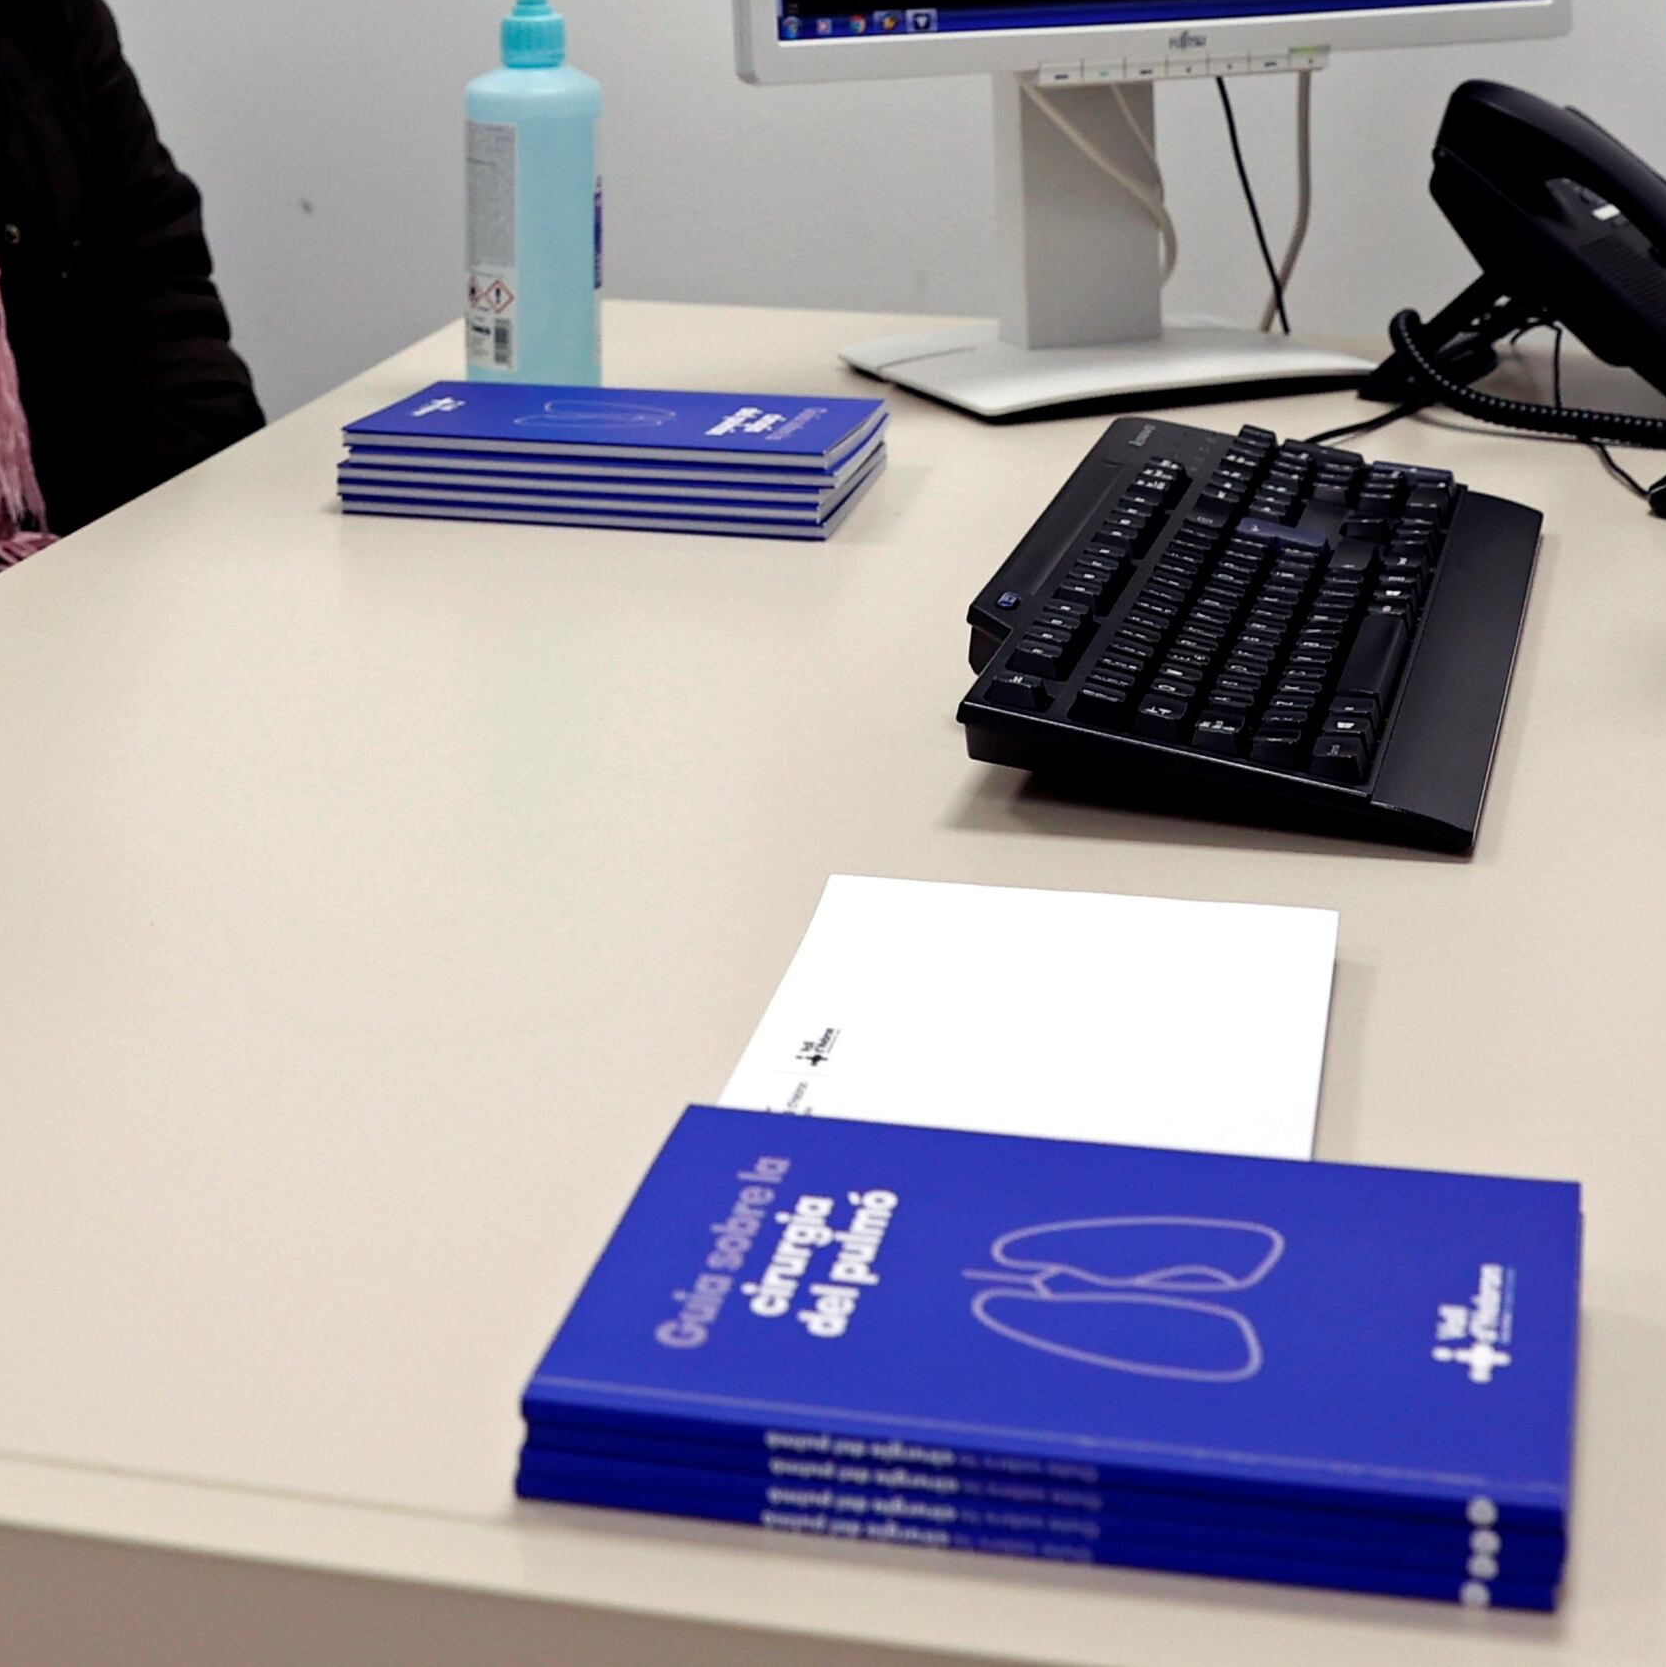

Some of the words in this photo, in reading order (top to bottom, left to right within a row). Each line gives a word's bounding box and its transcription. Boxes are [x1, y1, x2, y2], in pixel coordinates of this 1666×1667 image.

[736, 1156, 790, 1183] la
[706, 1185, 775, 1270] sobre
[740, 1194, 834, 1317] cirurgia
[796, 1283, 860, 1338] del
[829, 1189, 898, 1285] pulmó
[655, 1271, 733, 1348] Guia
